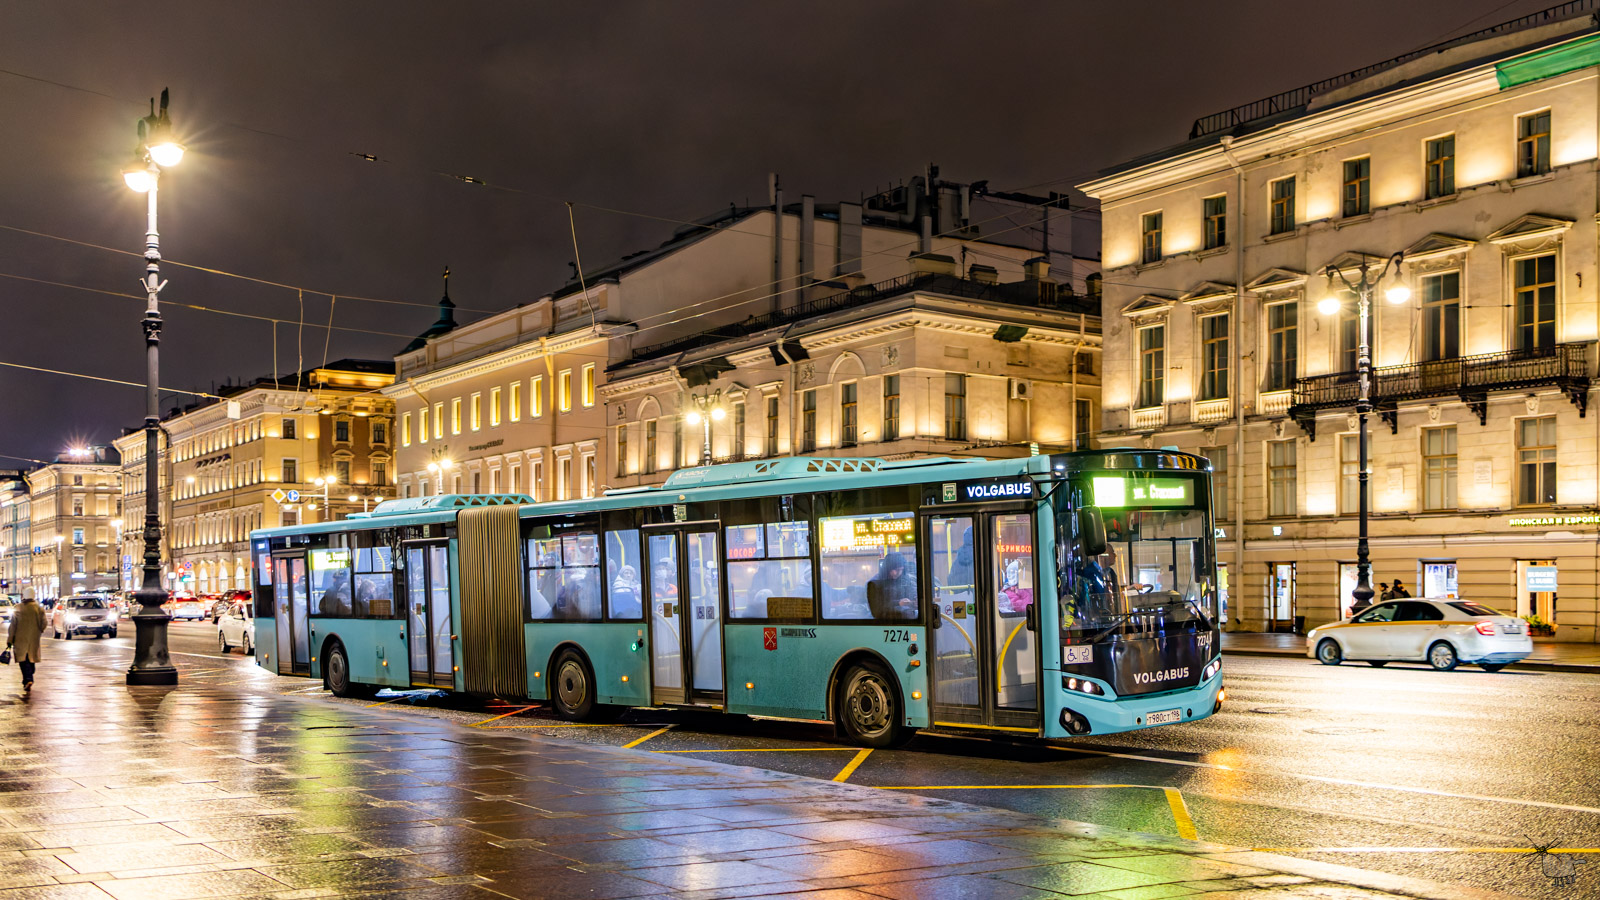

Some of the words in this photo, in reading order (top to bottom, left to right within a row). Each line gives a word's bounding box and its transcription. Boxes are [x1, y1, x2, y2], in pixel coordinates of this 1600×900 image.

[967, 483, 1032, 497] VOLGABUS
[872, 519, 912, 532] Стасовой
[1509, 517, 1554, 526] ЯПОНСКАЯ
[1556, 517, 1562, 525] И
[884, 630, 909, 643] 7274
[1133, 667, 1190, 684] VOLGABUS
